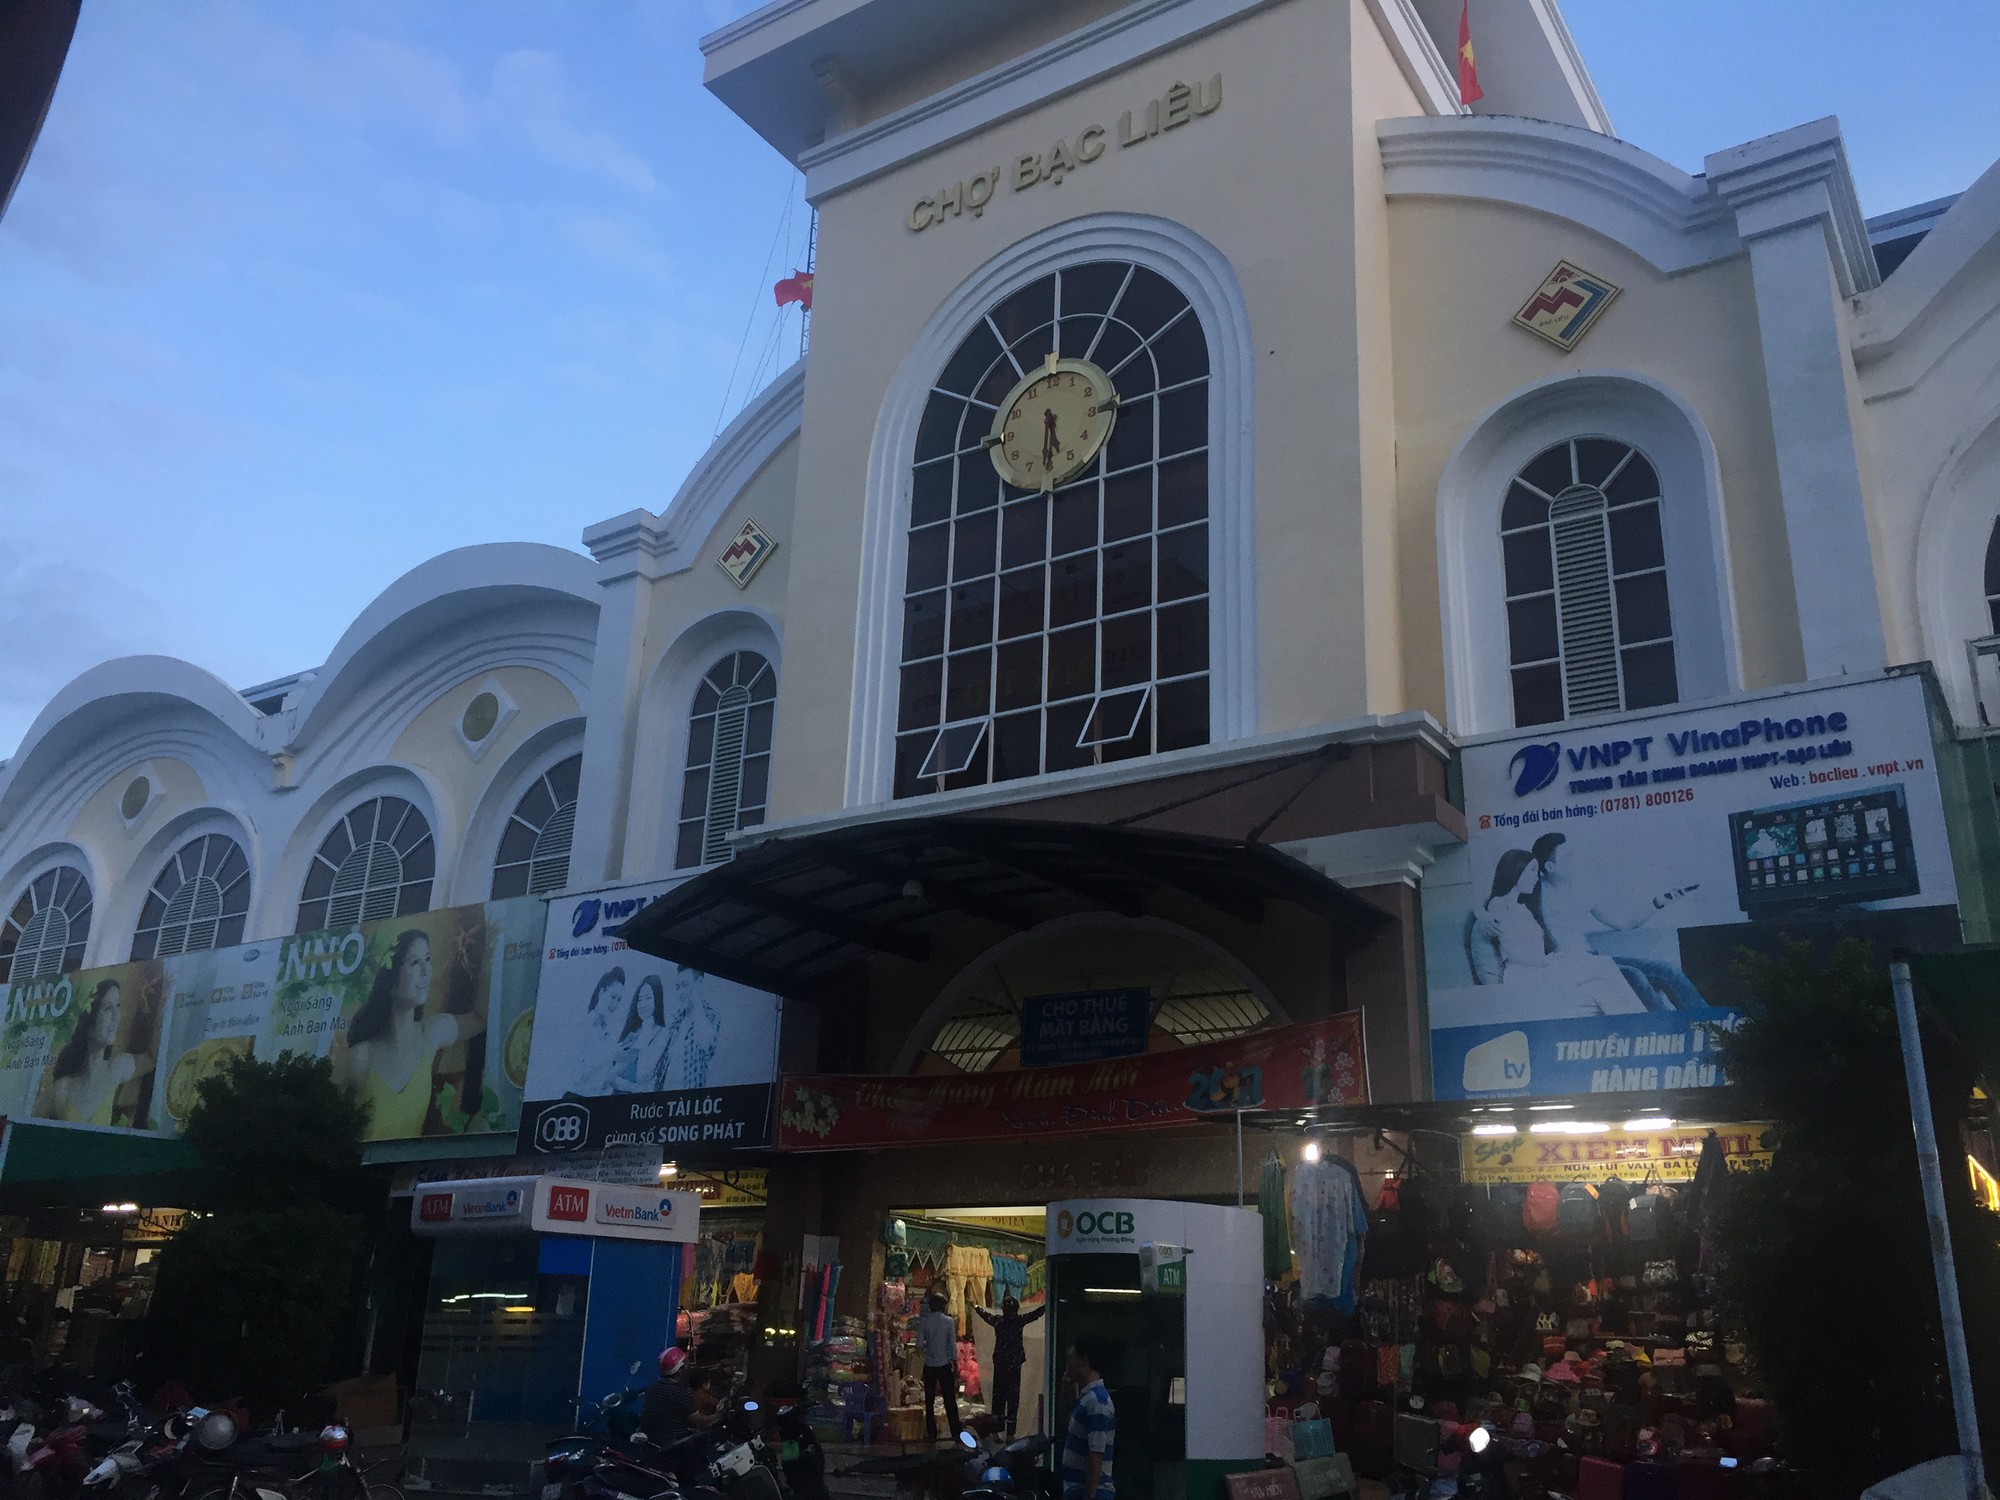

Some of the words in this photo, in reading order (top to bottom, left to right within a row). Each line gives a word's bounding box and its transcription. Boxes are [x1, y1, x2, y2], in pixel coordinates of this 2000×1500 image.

[907, 165, 1001, 232] CHỢ
[1014, 123, 1106, 192] BẠC
[1120, 72, 1224, 148] LIÊU
[1046, 376, 1060, 389] 12
[1027, 389, 1038, 400] 11
[1084, 387, 1092, 397] 2
[1011, 409, 1022, 419] 10
[1088, 406, 1097, 417] 3
[1007, 431, 1015, 441] 9
[1080, 429, 1088, 440] 4
[1067, 449, 1075, 460] 5
[1025, 461, 1034, 472] 7
[1567, 736, 1654, 771] VNPT
[1667, 711, 1848, 757] VinaPhone
[1494, 813, 1520, 828] Tổng
[1522, 811, 1540, 824] đài
[1542, 807, 1563, 821] bán
[1600, 795, 1641, 813] (0781)
[1645, 788, 1694, 807] 800126
[604, 896, 647, 920] VNPT
[1042, 1000, 1078, 1017] CHO
[306, 1020, 327, 1034] Ban
[1556, 1032, 1630, 1061] TRUYỀN
[1591, 1064, 1657, 1093] HÀNG
[630, 1103, 664, 1119] Rước
[667, 1097, 691, 1117] TÀI
[694, 1094, 723, 1118] LỘC
[542, 1116, 581, 1142] 088
[639, 1126, 656, 1143] số
[658, 1126, 700, 1143] SONG
[702, 1119, 746, 1142] PHÁT
[423, 1198, 448, 1214] ATM
[463, 1200, 507, 1214] VietinBank
[554, 1194, 585, 1212] ATM
[605, 1203, 660, 1222] VietinBank
[1076, 1211, 1135, 1234] OCB
[1163, 1268, 1180, 1286] ATM
